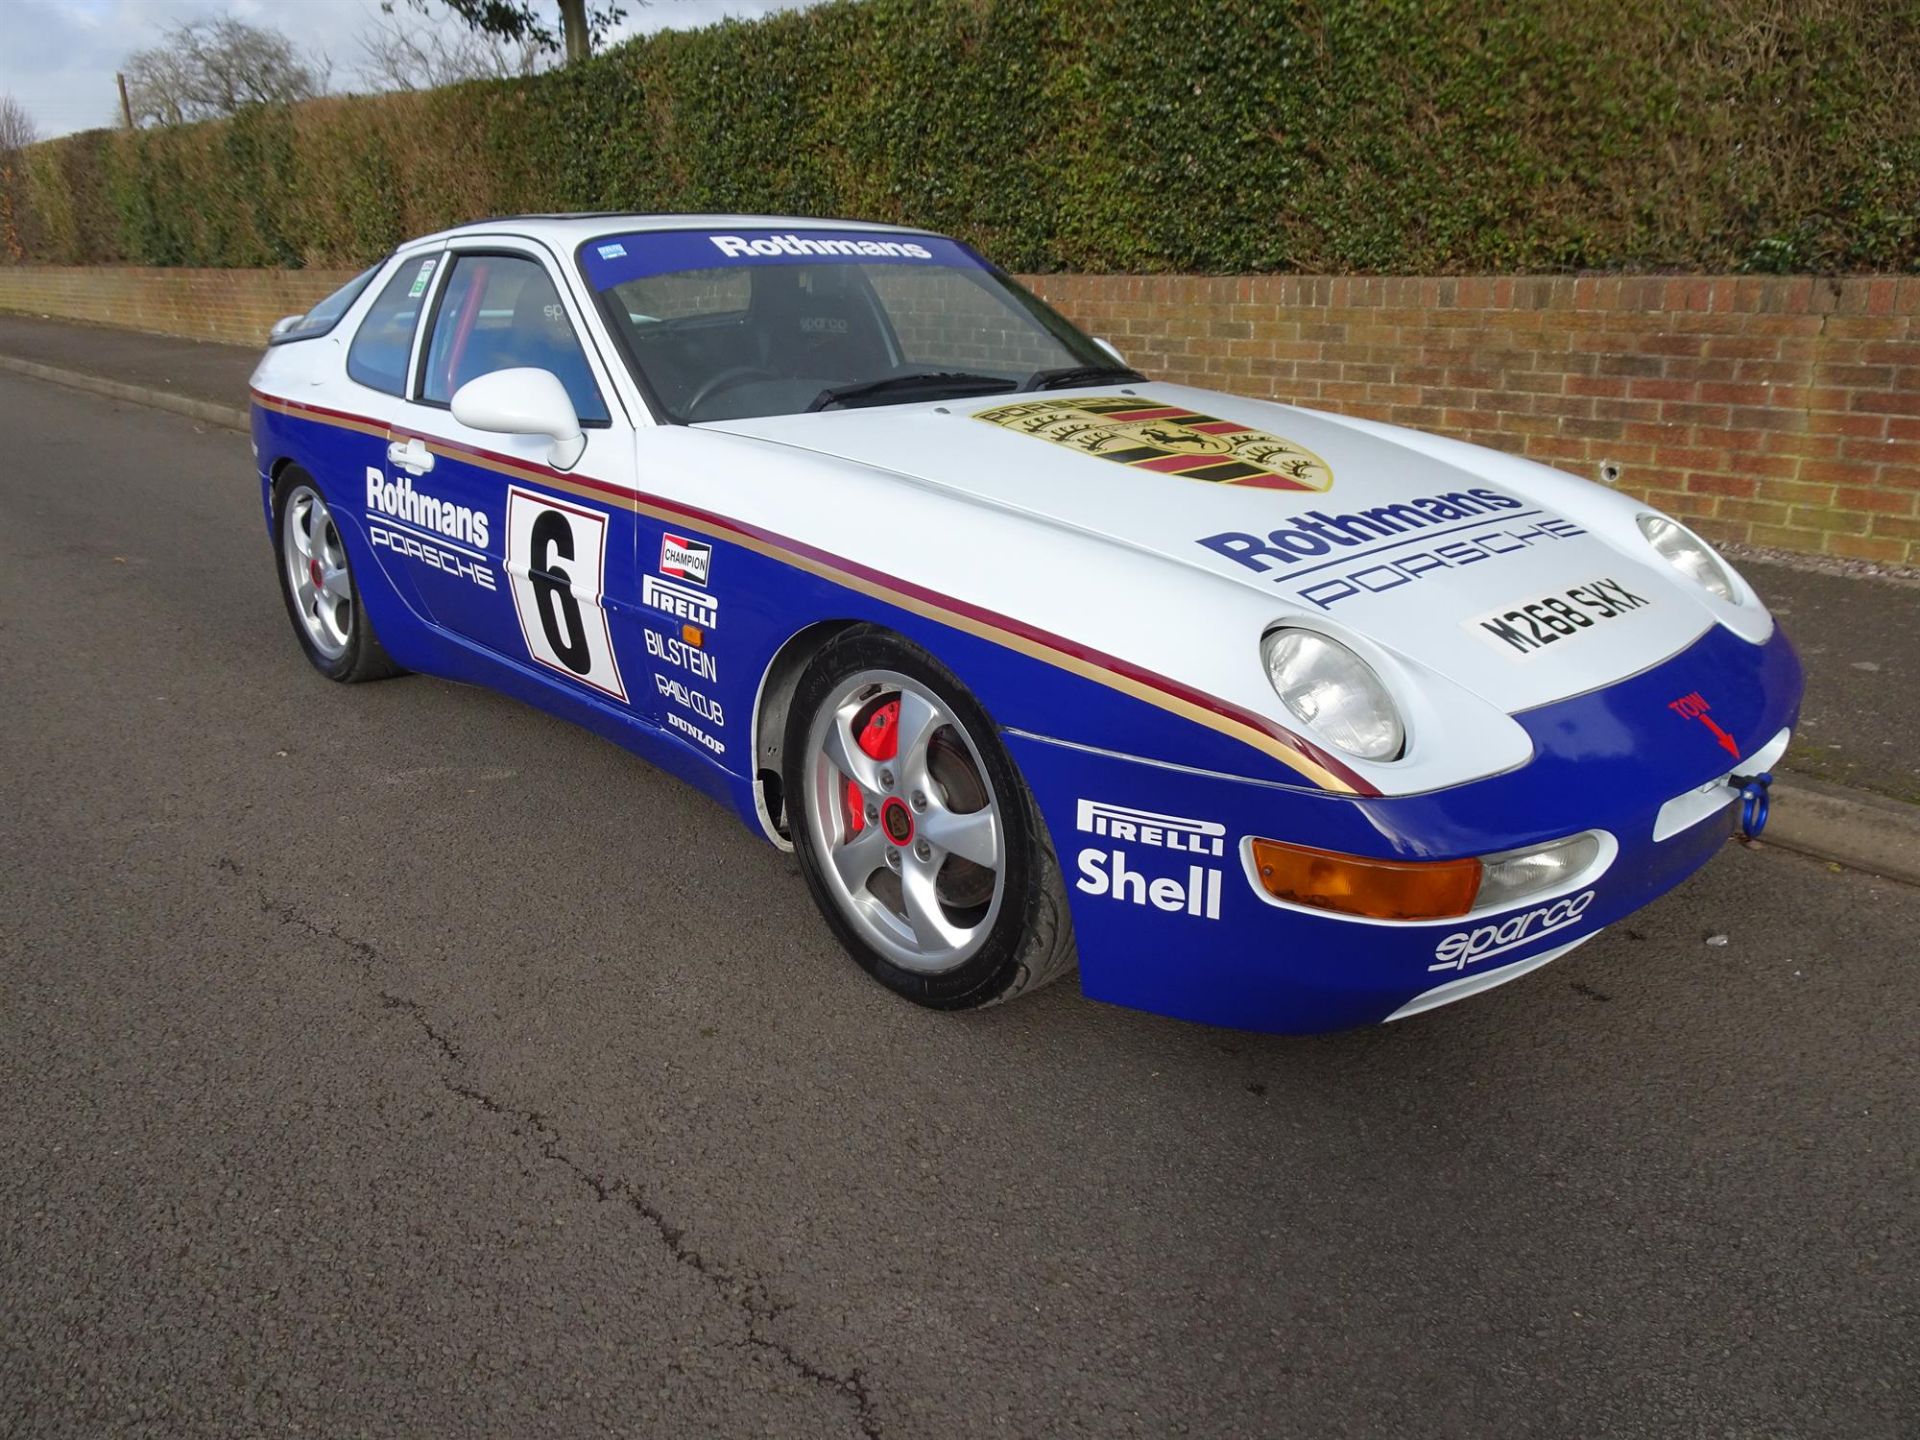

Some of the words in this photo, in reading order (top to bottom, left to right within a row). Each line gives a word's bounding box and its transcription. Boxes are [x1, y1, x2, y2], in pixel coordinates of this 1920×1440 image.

[710, 235, 931, 260] Rothmans
[367, 466, 489, 549] Rothmans
[1195, 487, 1525, 573] Rothmans
[370, 526, 496, 591] PORSCHE
[665, 548, 706, 571] CHAMPION
[1296, 518, 1588, 610] PORSCHE
[530, 510, 591, 675] 6
[643, 574, 718, 629] PIRELLI
[1480, 597, 1587, 654] M268
[1575, 578, 1650, 628] SKX
[643, 628, 717, 684] BILSTEIN
[655, 673, 691, 708] RALLY
[690, 691, 724, 727] CLUB
[1668, 691, 1711, 720] TOW
[667, 712, 725, 754] DUNLOP
[1077, 799, 1226, 856] PIRELLI
[1076, 848, 1222, 920] Shell
[1430, 890, 1594, 970] sparco
